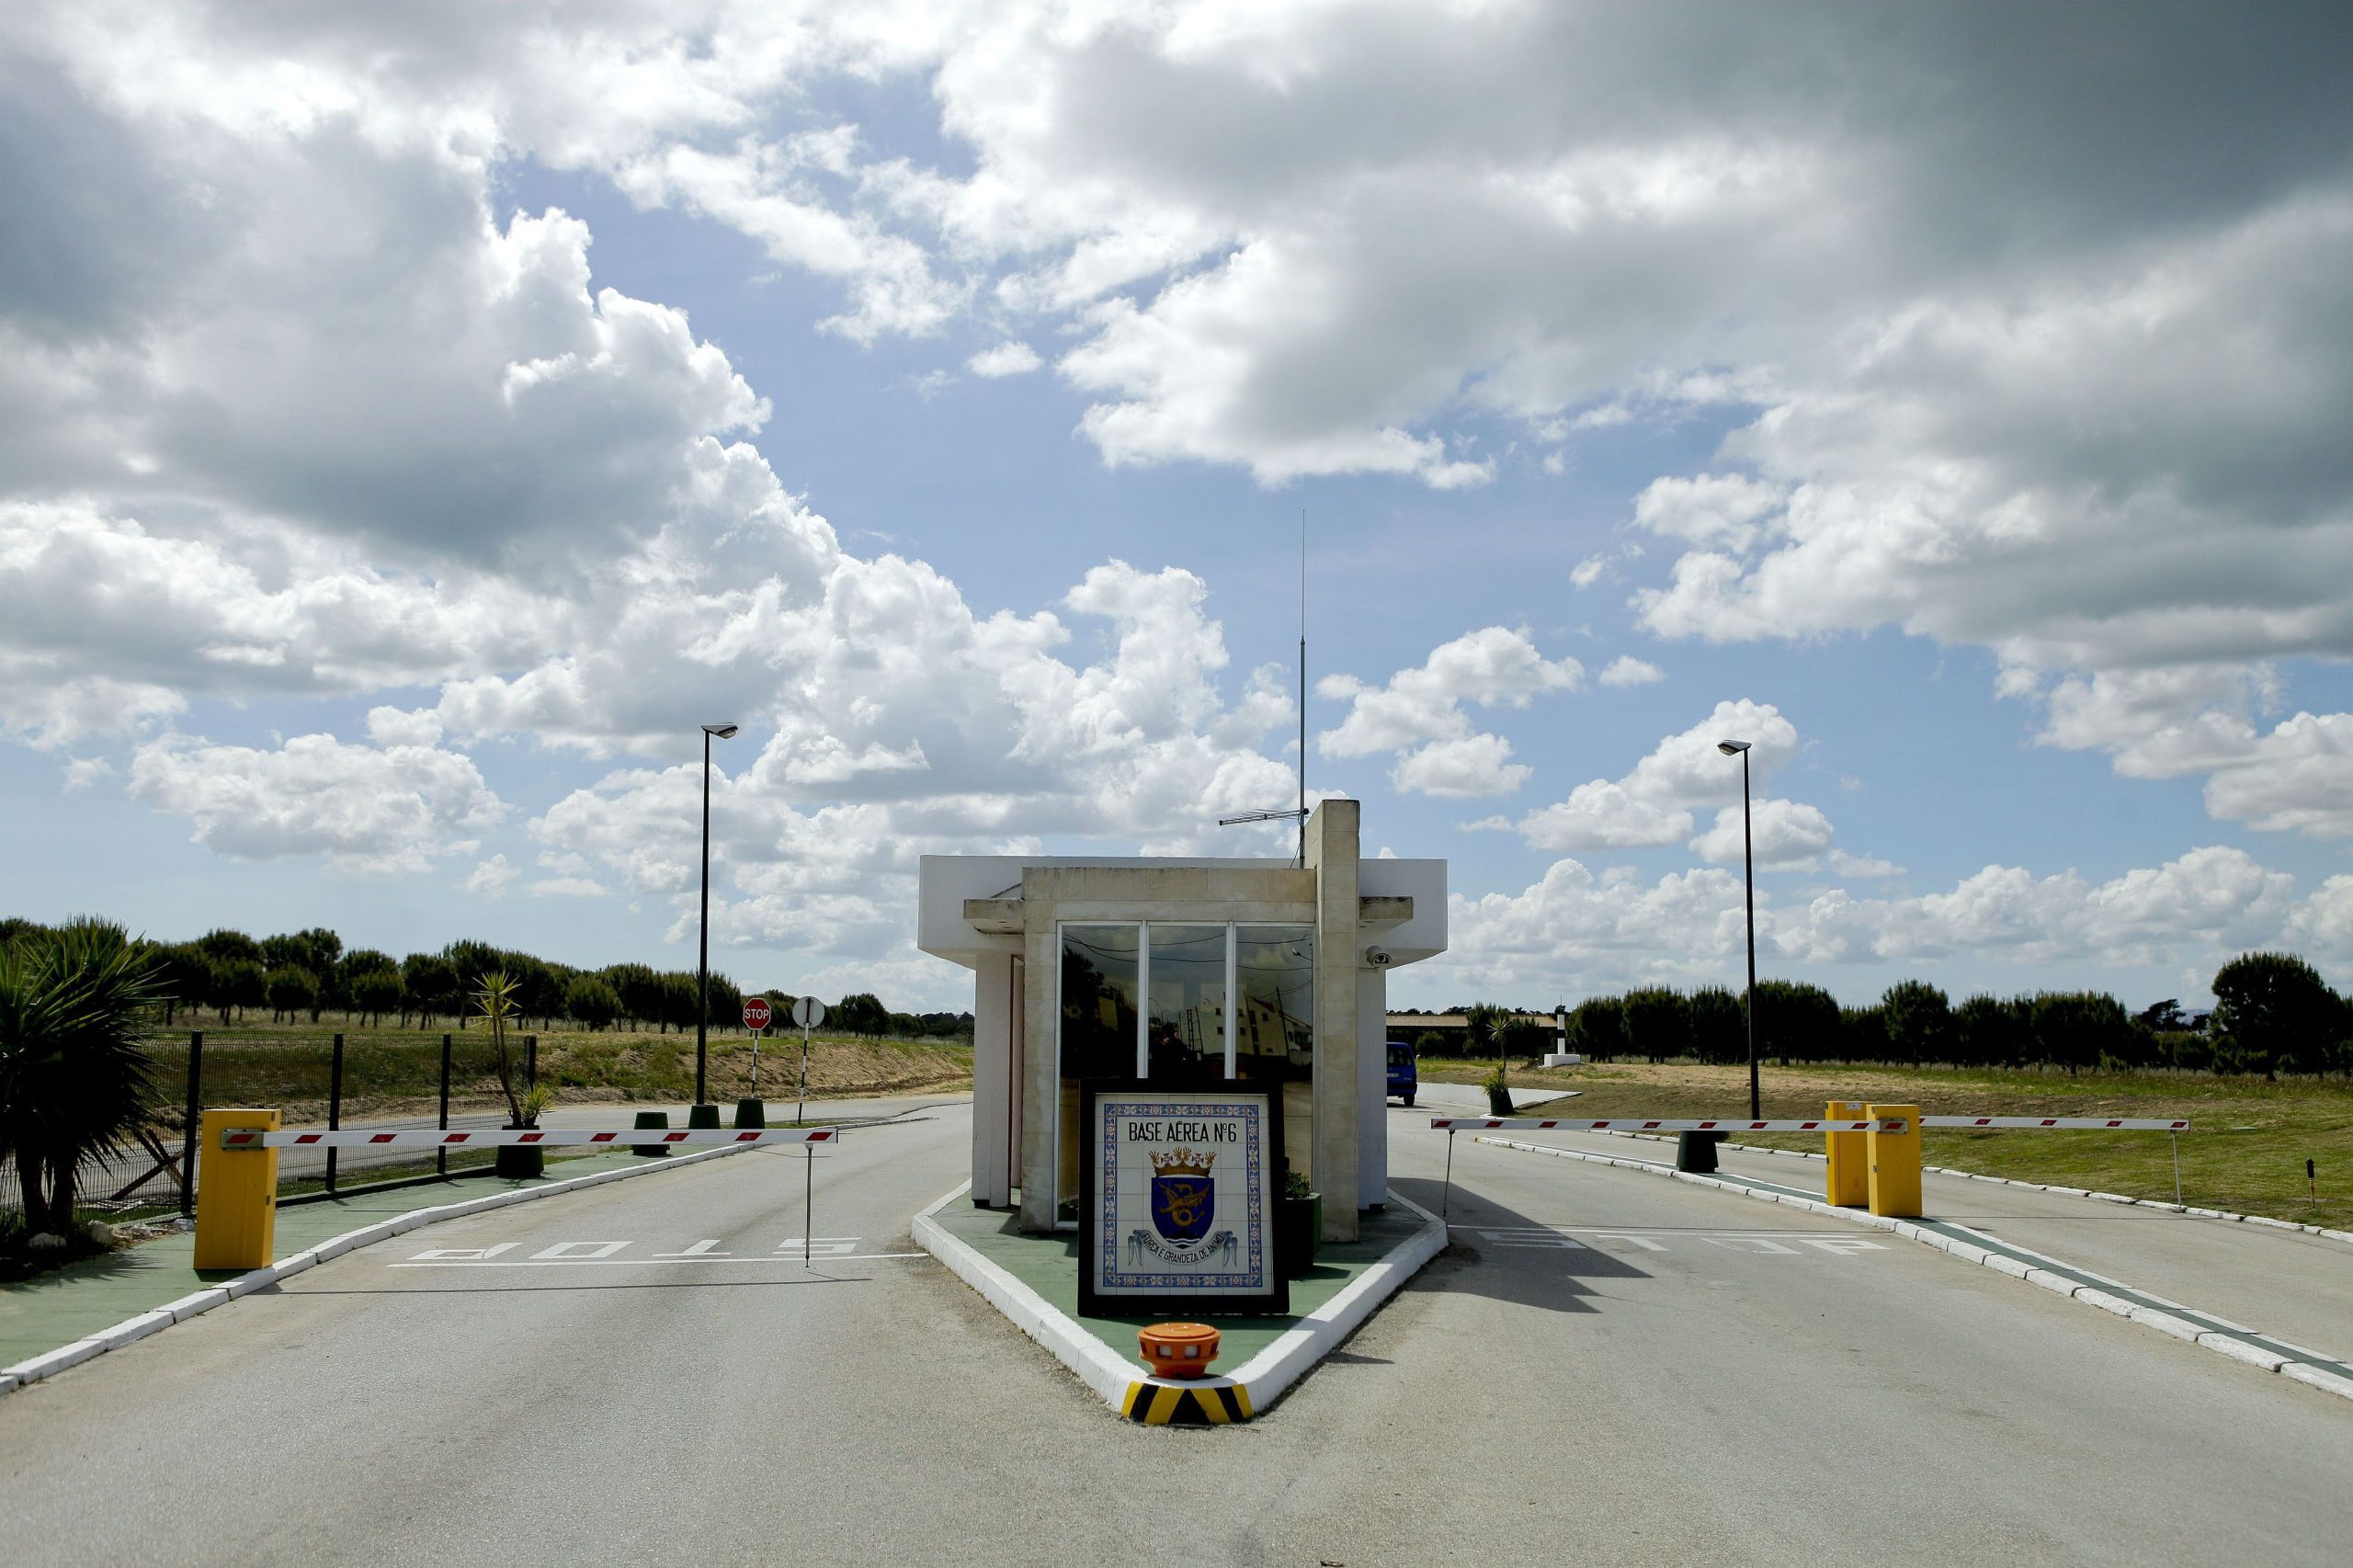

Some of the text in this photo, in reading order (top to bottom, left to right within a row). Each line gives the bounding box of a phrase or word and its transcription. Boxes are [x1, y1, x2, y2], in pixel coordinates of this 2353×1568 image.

[745, 1008, 769, 1019] STOP
[1129, 1122, 1163, 1142] BASE
[1166, 1120, 1210, 1142] AÉREA
[1477, 1231, 1892, 1256] STOP
[1158, 1248, 1165, 1258] E
[1164, 1251, 1199, 1264] GRANDEZA
[1199, 1248, 1209, 1259] DE
